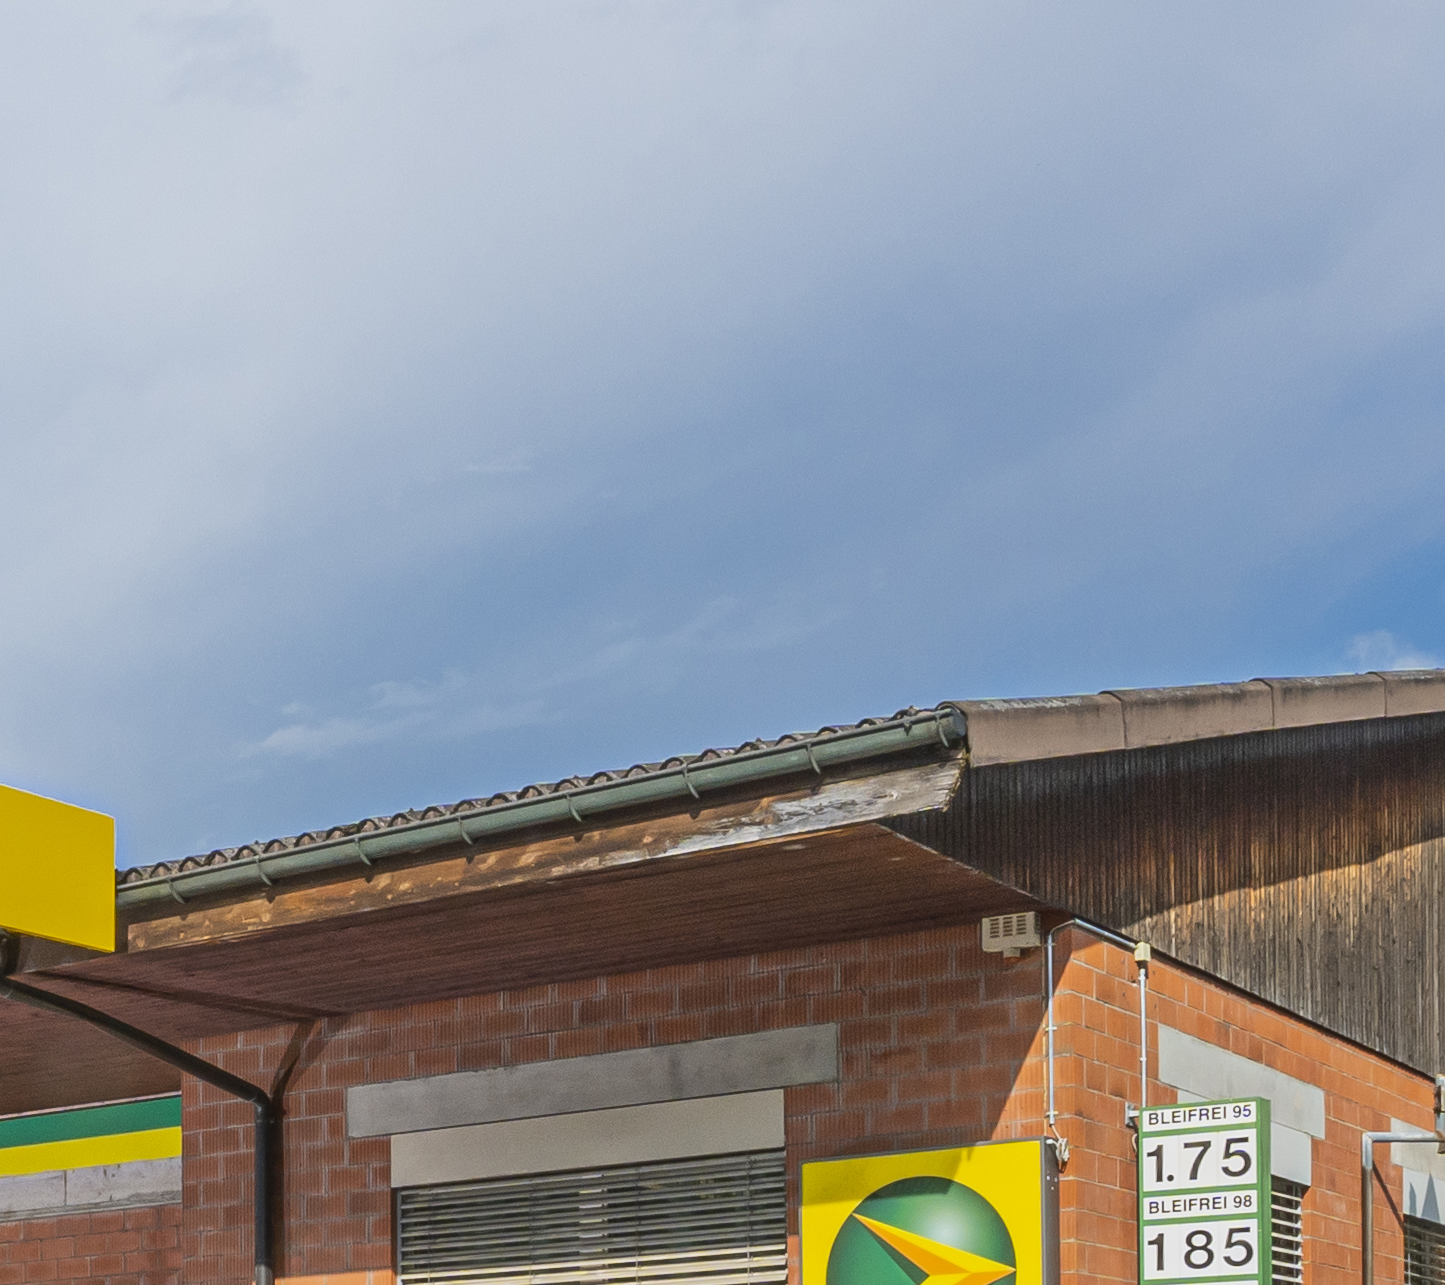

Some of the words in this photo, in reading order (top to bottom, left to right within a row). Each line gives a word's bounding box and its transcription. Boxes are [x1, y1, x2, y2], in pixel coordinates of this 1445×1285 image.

[1148, 1106, 1227, 1126] BLEIFREI
[1232, 1104, 1252, 1118] 95
[1146, 1136, 1252, 1183] 1.75
[1149, 1196, 1228, 1215] BLEIFREI
[1233, 1194, 1253, 1209] 98
[1147, 1226, 1254, 1272] 185
